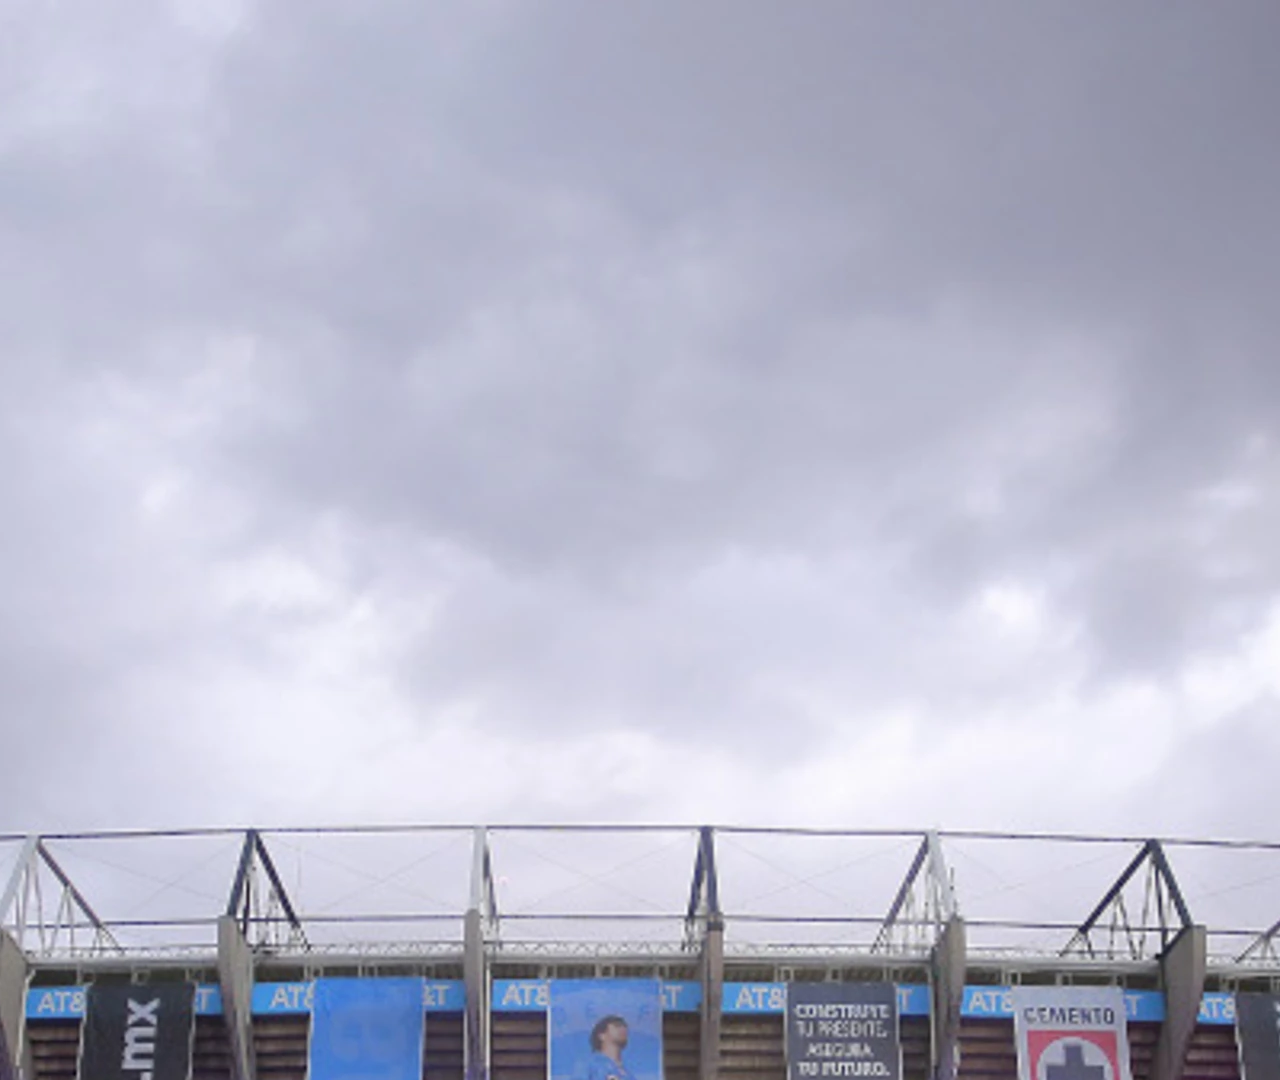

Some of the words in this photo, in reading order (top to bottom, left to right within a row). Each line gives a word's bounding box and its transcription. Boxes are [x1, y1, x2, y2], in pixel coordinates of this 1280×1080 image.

[37, 992, 84, 1014] AT&
[502, 984, 549, 1007] AT&
[735, 987, 786, 1010] AT&
[969, 992, 1014, 1015] AT&
[1023, 1006, 1115, 1026] CEMENTO
